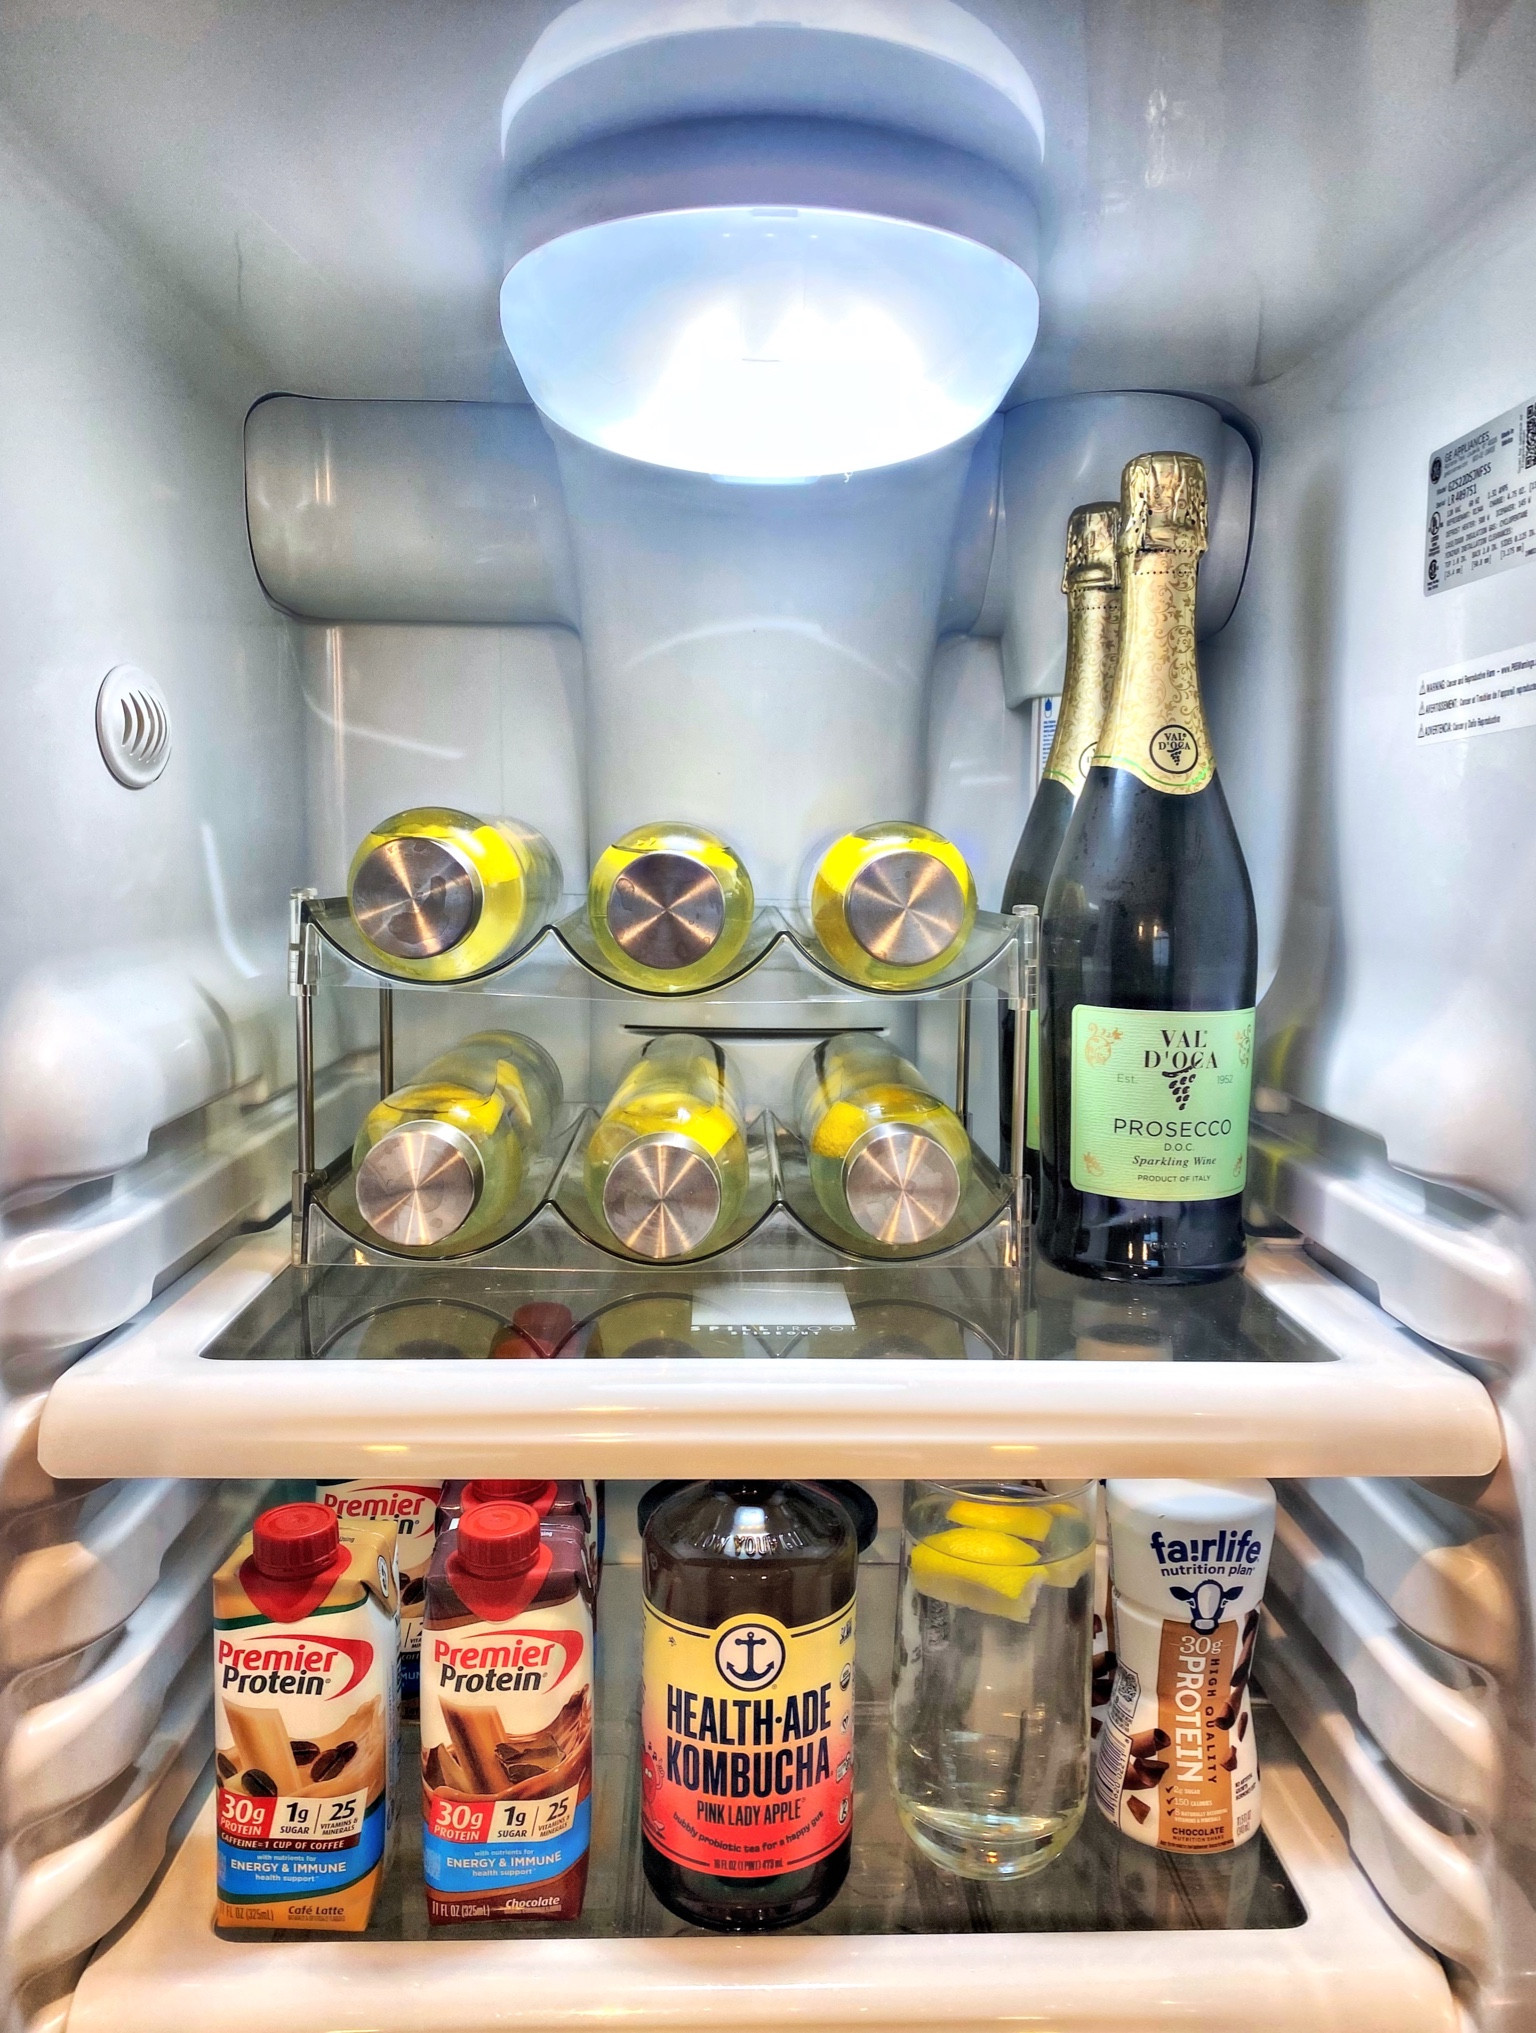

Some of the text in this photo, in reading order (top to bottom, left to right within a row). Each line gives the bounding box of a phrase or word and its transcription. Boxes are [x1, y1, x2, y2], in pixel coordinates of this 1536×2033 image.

[1164, 732, 1184, 741] VAL
[1161, 1029, 1207, 1048] VAL
[1144, 1050, 1218, 1069] D'OCA
[1217, 1075, 1233, 1084] 1952
[1114, 1118, 1232, 1137] PROSECCO
[1132, 1155, 1217, 1168] Sparkling Wine
[1137, 1174, 1177, 1182] PRODUCT
[1192, 1174, 1210, 1182] ITALY
[324, 1492, 426, 1517] Premier
[1161, 1564, 1254, 1577] nutrition plan
[434, 1639, 555, 1669] Premier
[1179, 1636, 1223, 1654] 30g
[218, 1639, 339, 1672] Premier
[222, 1664, 324, 1695] Protein
[440, 1664, 541, 1693] Protein
[1175, 1655, 1206, 1782] PROTEIN
[1205, 1658, 1220, 1784] HIGH QUALITY
[667, 1735, 830, 1798] KOMBUCHA
[221, 1794, 265, 1825] 30g
[329, 1799, 357, 1821] 25
[547, 1797, 569, 1822] 25
[1175, 1798, 1188, 1806] 150
[286, 1802, 309, 1823] 1g
[436, 1801, 483, 1830] 30g
[504, 1806, 526, 1827] 1g
[697, 1798, 801, 1826] PINK LADY APPLE
[220, 1816, 262, 1836] PROTEIN
[280, 1826, 310, 1834] SUGAR
[320, 1820, 351, 1829] VITAMINS
[322, 1825, 355, 1835] MINERALS
[434, 1825, 480, 1840] PROTEIN
[497, 1829, 527, 1838] SUGAR
[538, 1818, 565, 1831] VITAMINS
[673, 1811, 698, 1837] bubbly
[698, 1834, 741, 1852] probiotic
[744, 1845, 760, 1853] tea
[762, 1841, 777, 1851] for
[786, 1825, 811, 1844] happy
[811, 1811, 824, 1827] gut
[1172, 1826, 1224, 1836] CHOCOLATE
[295, 1841, 307, 1849] OF
[310, 1840, 345, 1850] COFFEE
[231, 1859, 346, 1873] ENERGY & IMMUNE
[446, 1850, 562, 1868] ENERGY & IMMUNE
[255, 1873, 280, 1881] health
[288, 1906, 344, 1915] Café Latte
[432, 1901, 439, 1915] 11
[441, 1904, 448, 1917] FL
[450, 1905, 460, 1917] OZ
[505, 1897, 560, 1908] Chocolate
